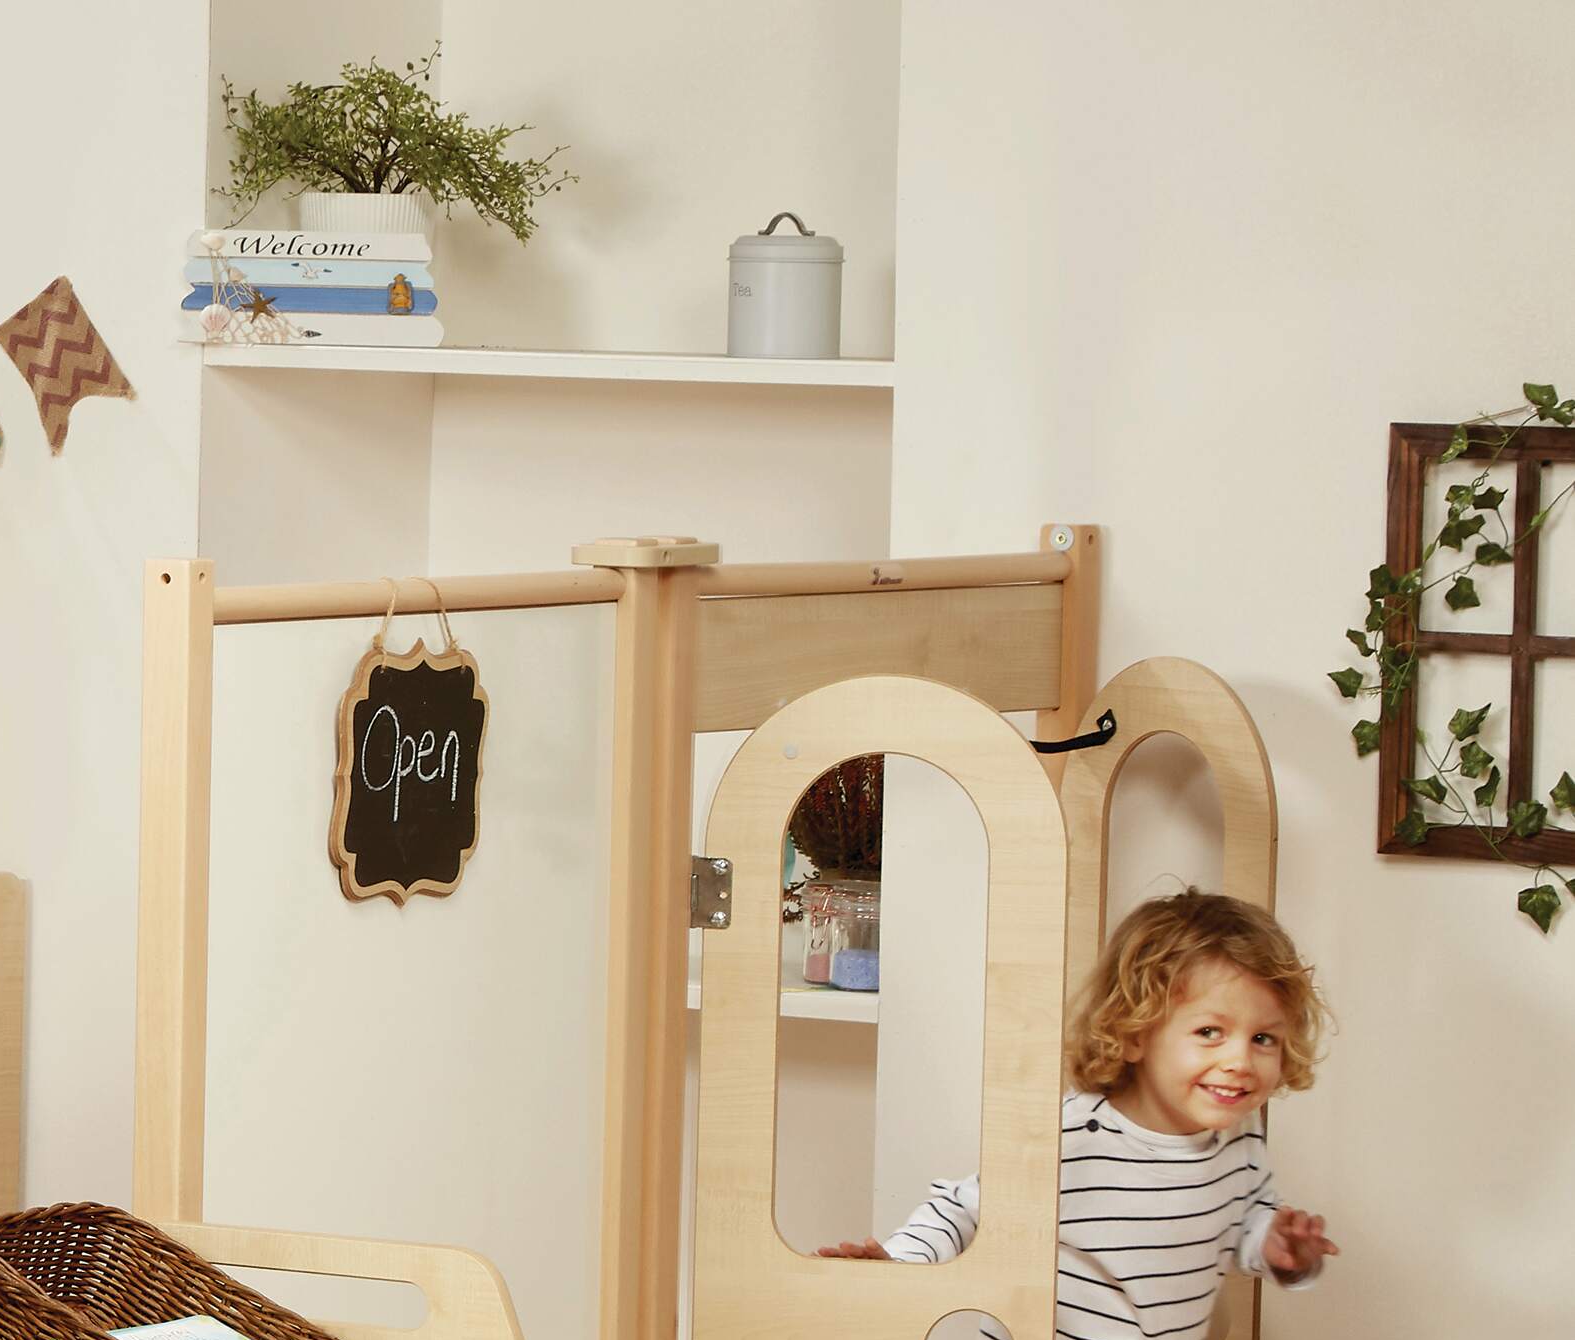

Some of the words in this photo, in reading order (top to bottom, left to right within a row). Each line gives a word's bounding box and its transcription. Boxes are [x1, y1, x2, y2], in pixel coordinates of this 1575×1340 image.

[233, 234, 371, 257] Welcome
[732, 282, 751, 297] Tea
[361, 704, 460, 822] Open
